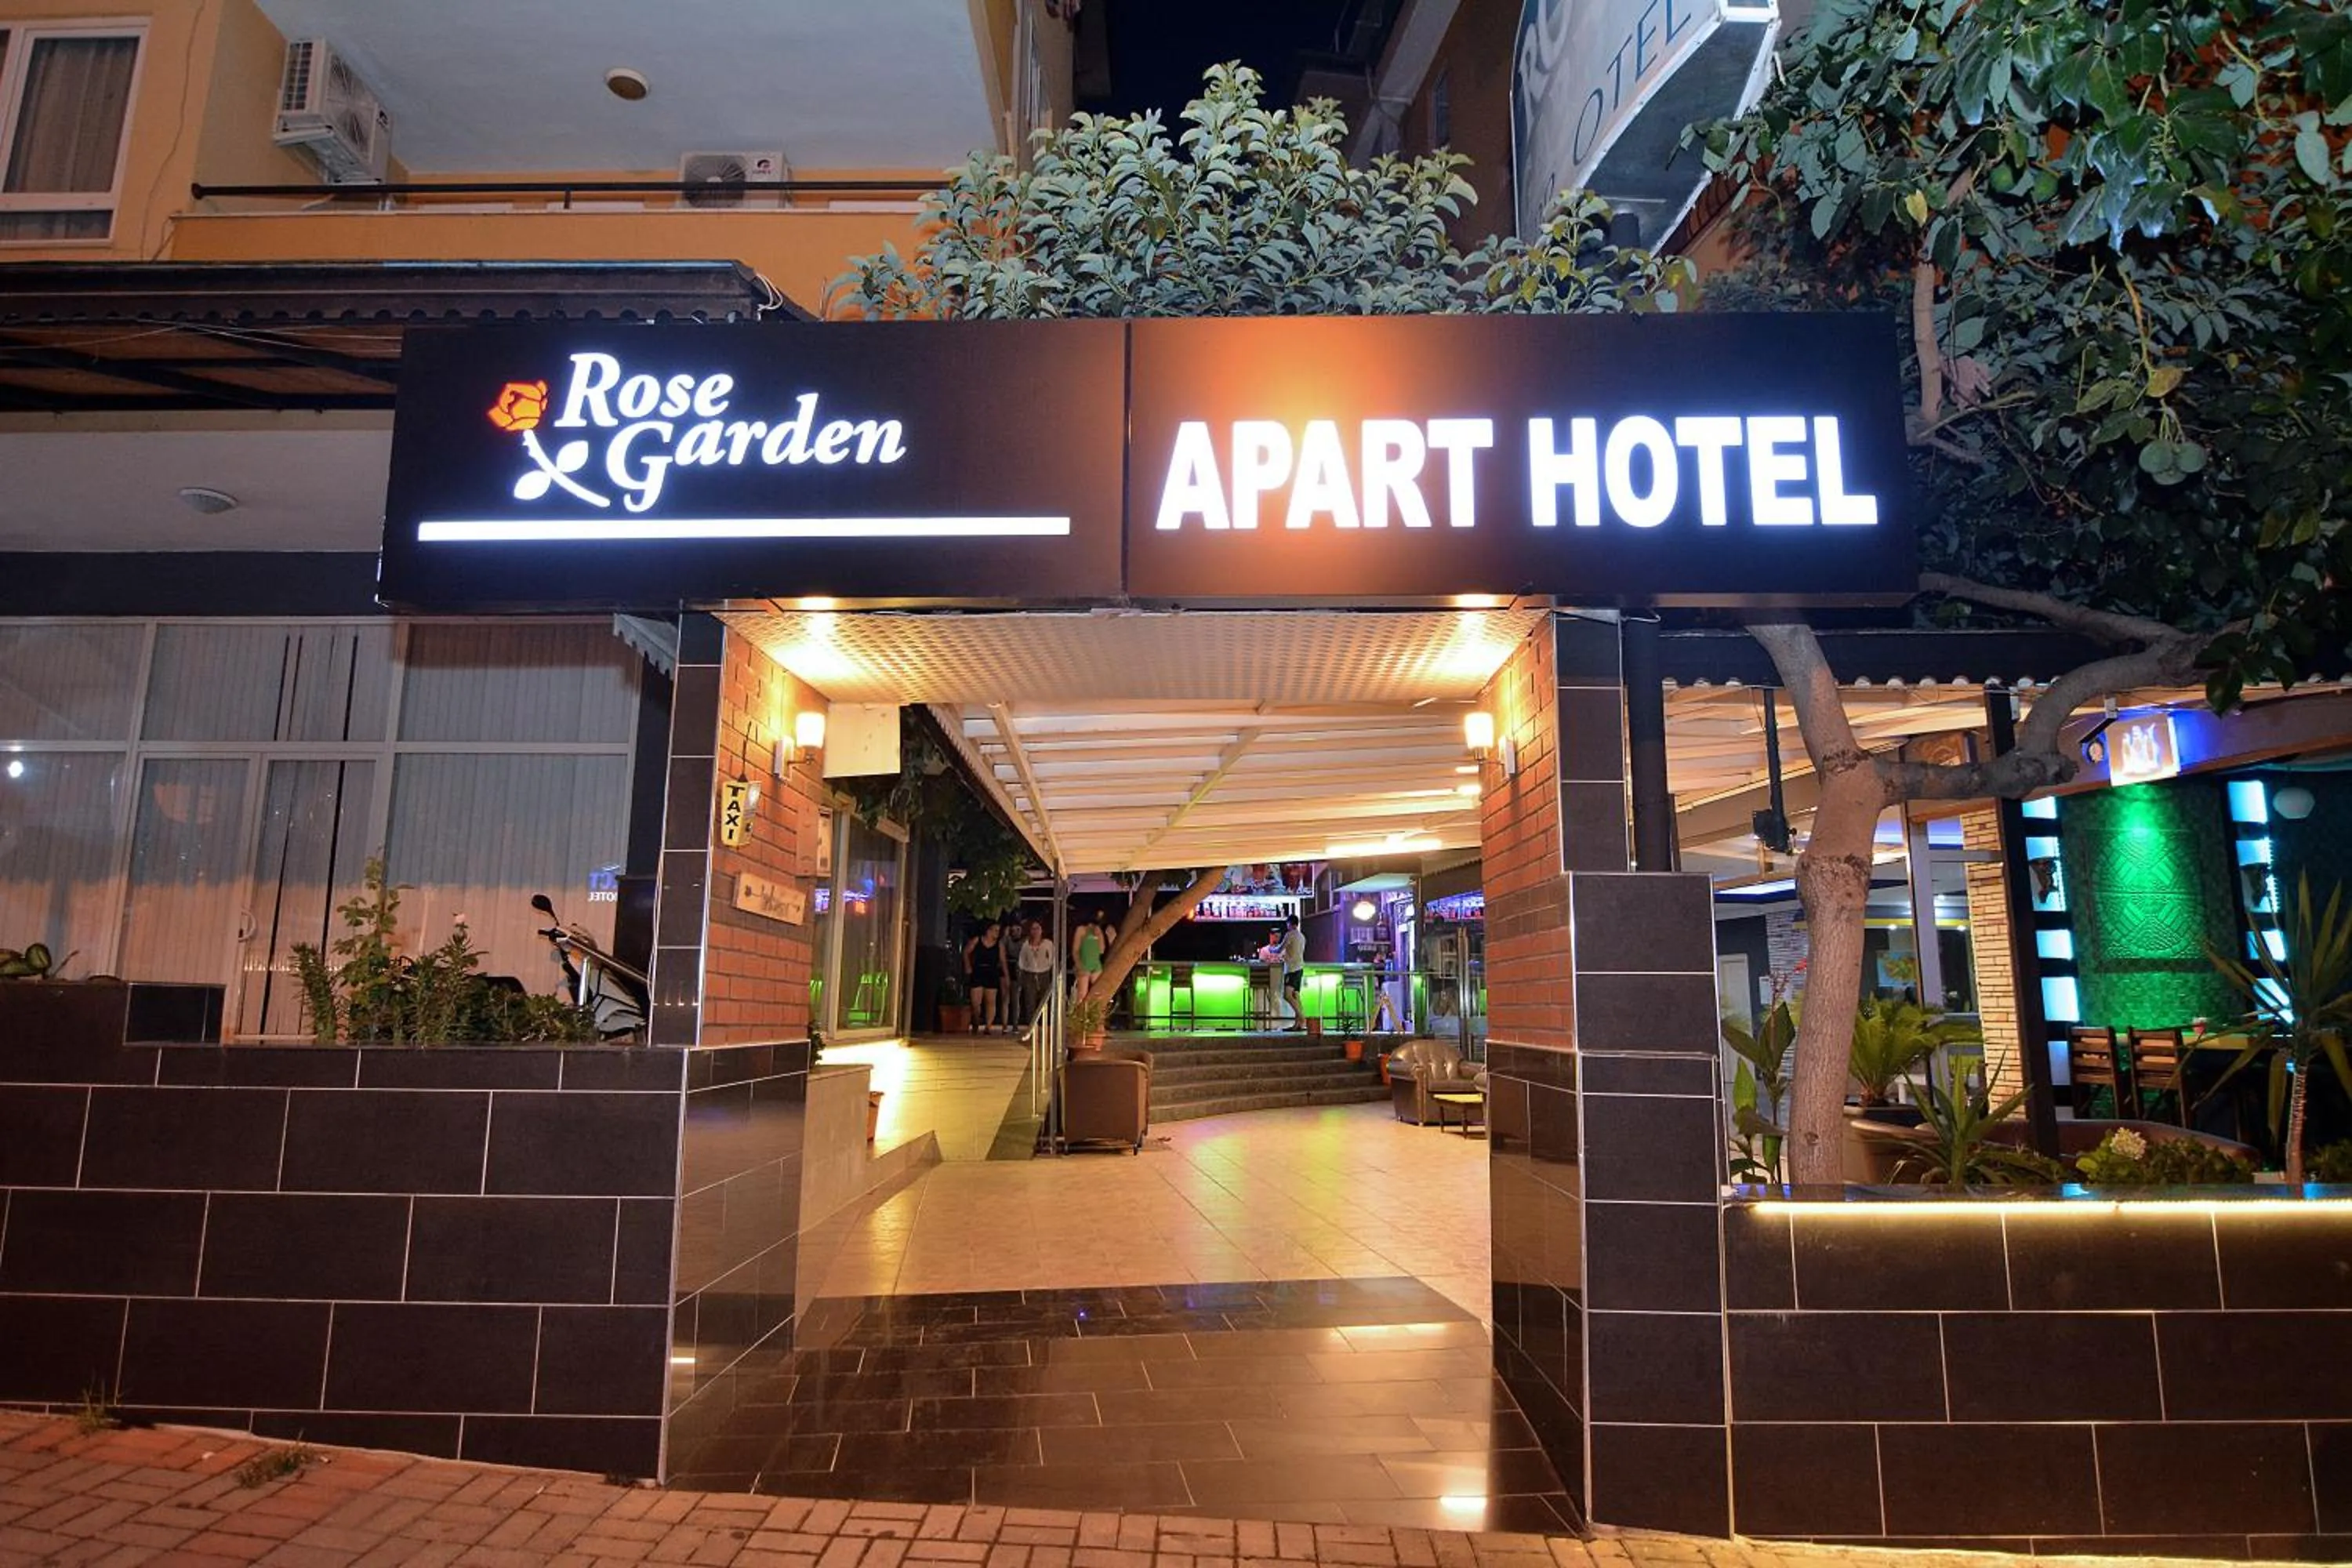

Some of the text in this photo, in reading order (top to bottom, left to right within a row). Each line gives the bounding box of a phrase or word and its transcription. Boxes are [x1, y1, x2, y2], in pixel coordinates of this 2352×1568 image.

[554, 353, 734, 428] Rose
[606, 393, 906, 513] Garden
[1156, 415, 1878, 530] APART HOTEL
[726, 785, 746, 840] TAXI
